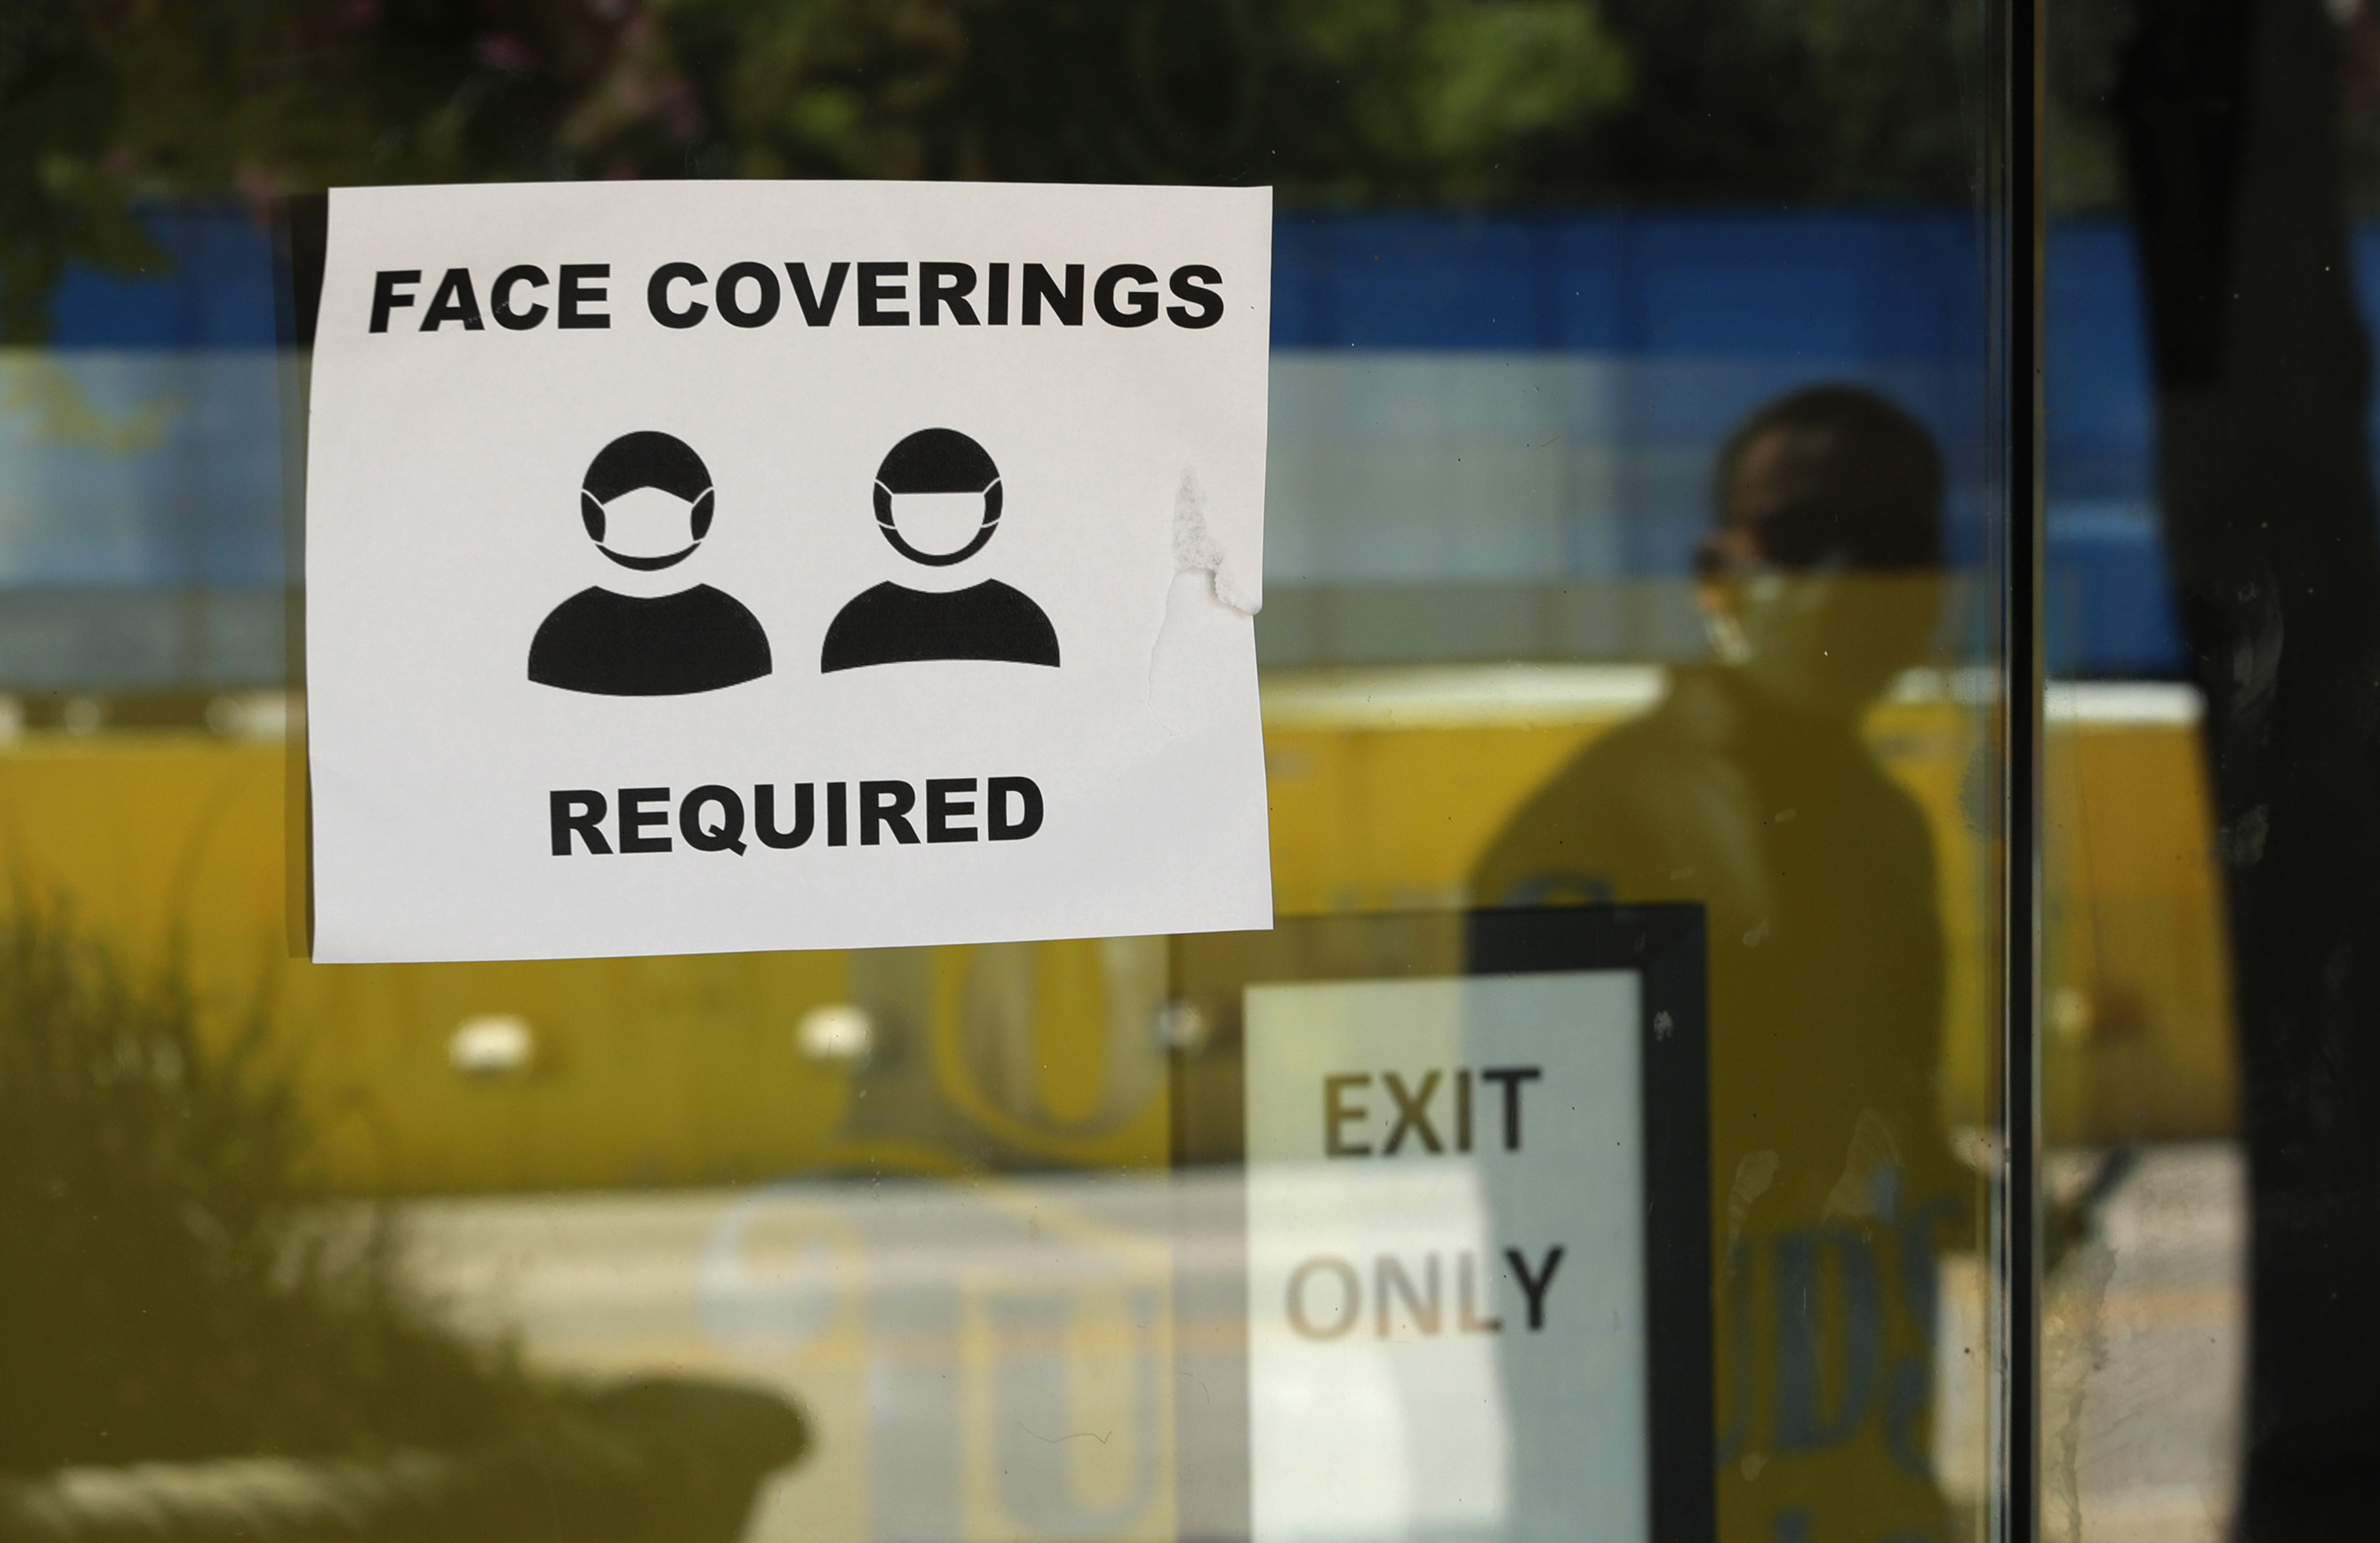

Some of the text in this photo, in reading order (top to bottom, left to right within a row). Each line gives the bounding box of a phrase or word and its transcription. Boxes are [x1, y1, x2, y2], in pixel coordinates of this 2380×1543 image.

[369, 261, 1224, 334] FACE COVERINGS
[550, 776, 1045, 857] REQUIRED
[1322, 1066, 1543, 1159] EXIT
[1284, 1244, 1565, 1343] ONLY
